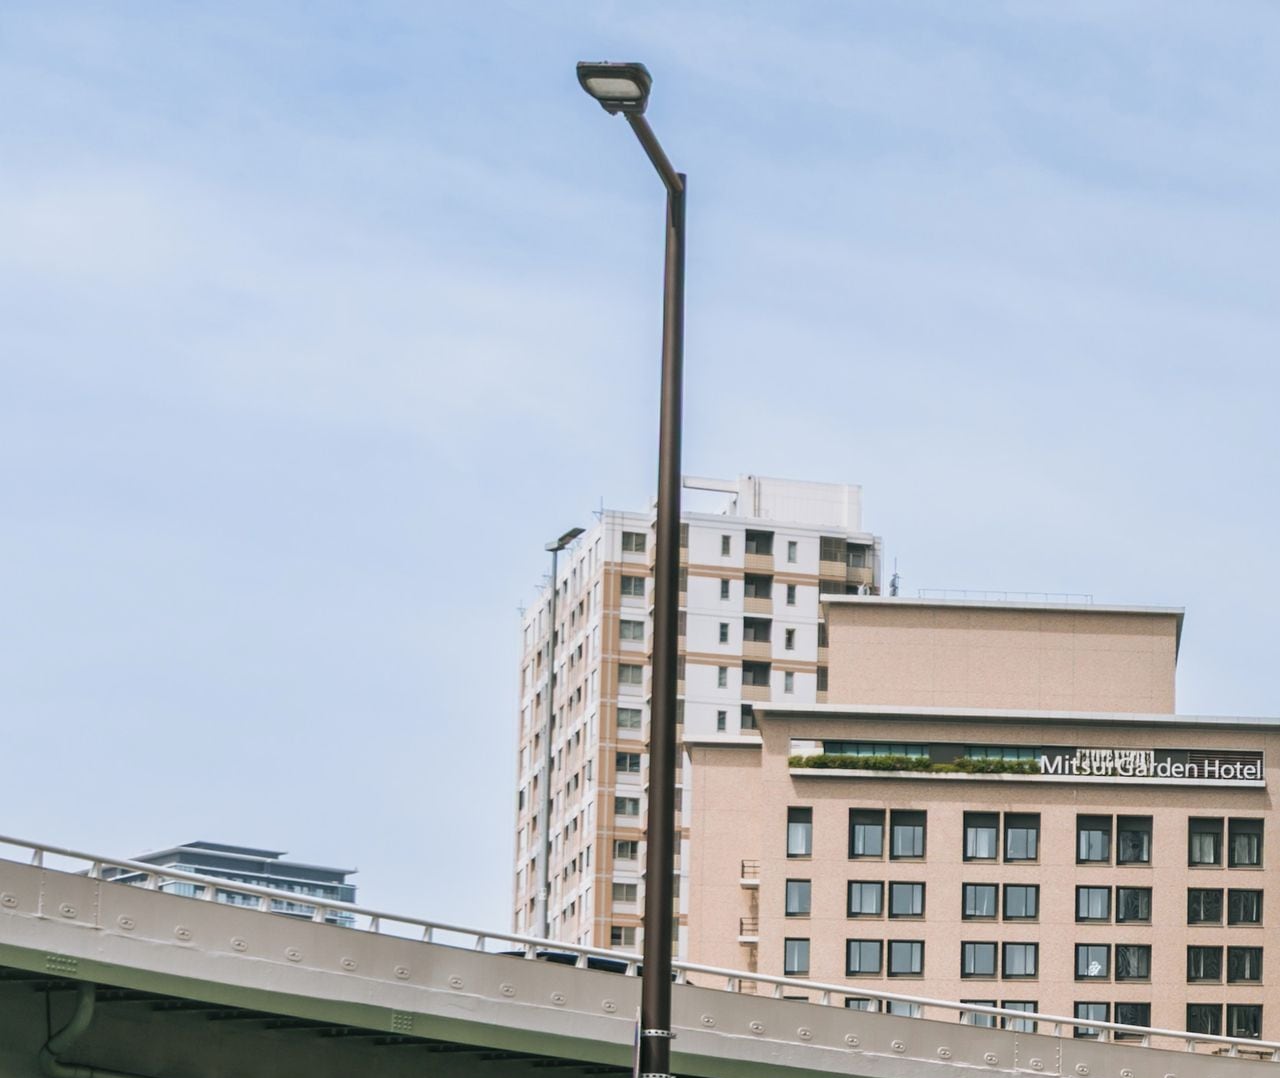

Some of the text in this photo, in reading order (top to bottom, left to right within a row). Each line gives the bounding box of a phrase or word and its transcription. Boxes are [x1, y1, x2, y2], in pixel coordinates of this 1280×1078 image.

[1040, 754, 1262, 780] Mitsui Garden Hotel
